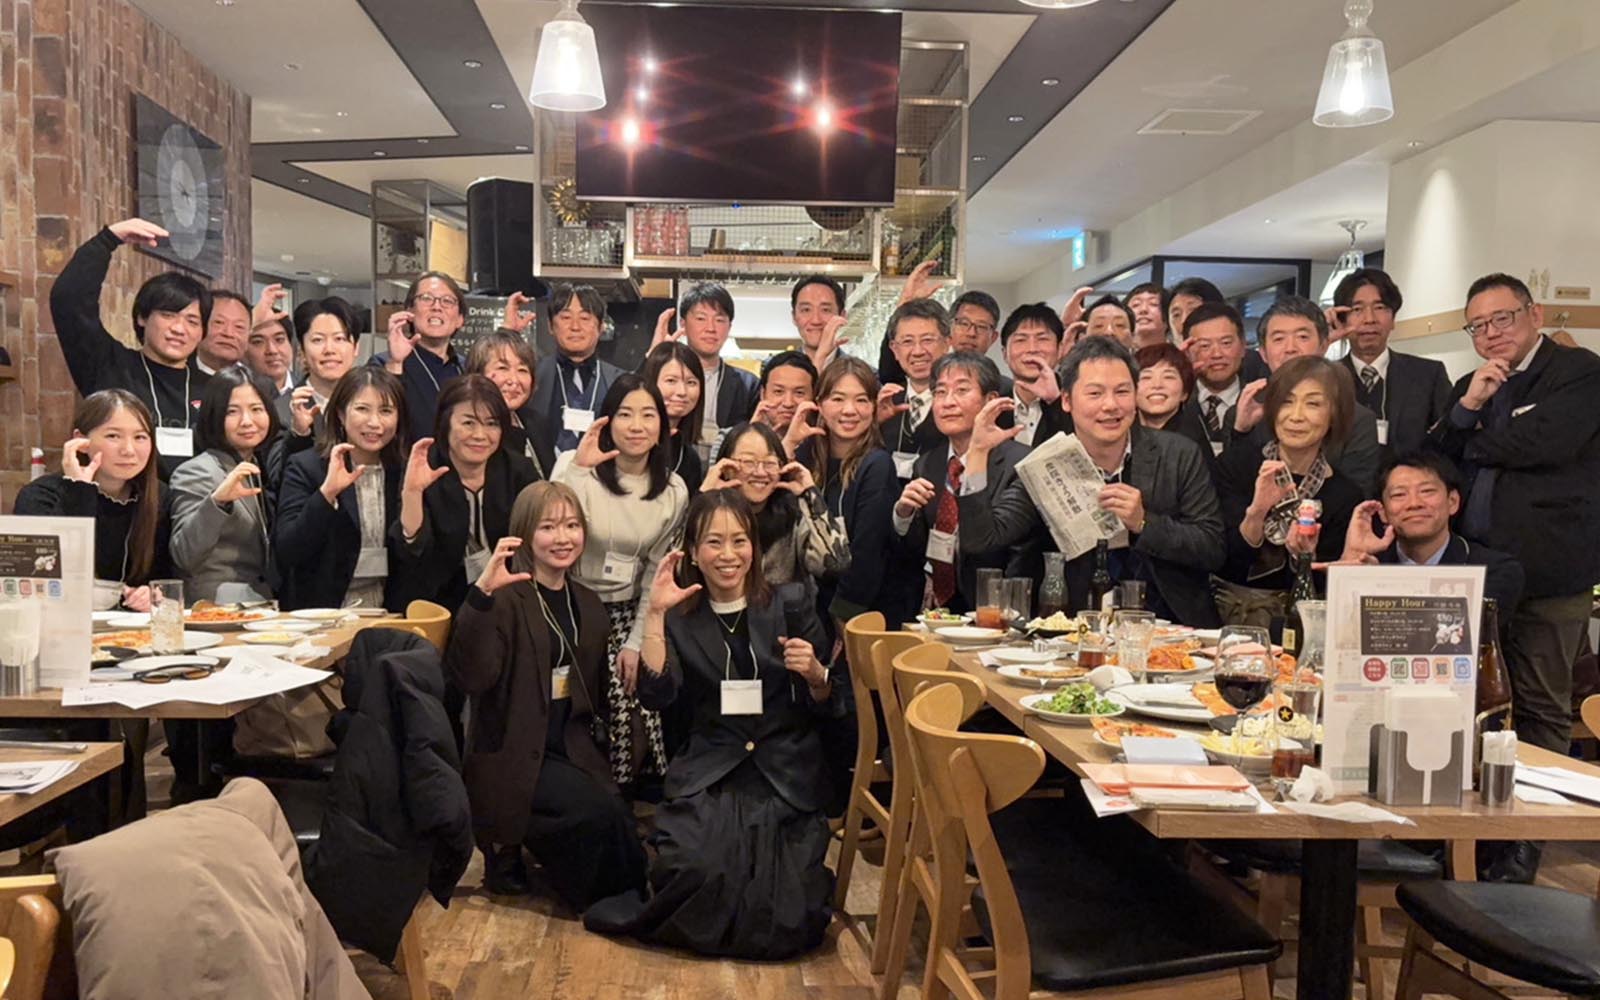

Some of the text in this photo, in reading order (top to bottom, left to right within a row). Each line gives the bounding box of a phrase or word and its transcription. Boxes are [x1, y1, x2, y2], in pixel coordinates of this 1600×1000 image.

[469, 307, 494, 316] Drink
[1365, 598, 1397, 609] Happy
[1401, 598, 1426, 607] Hour
